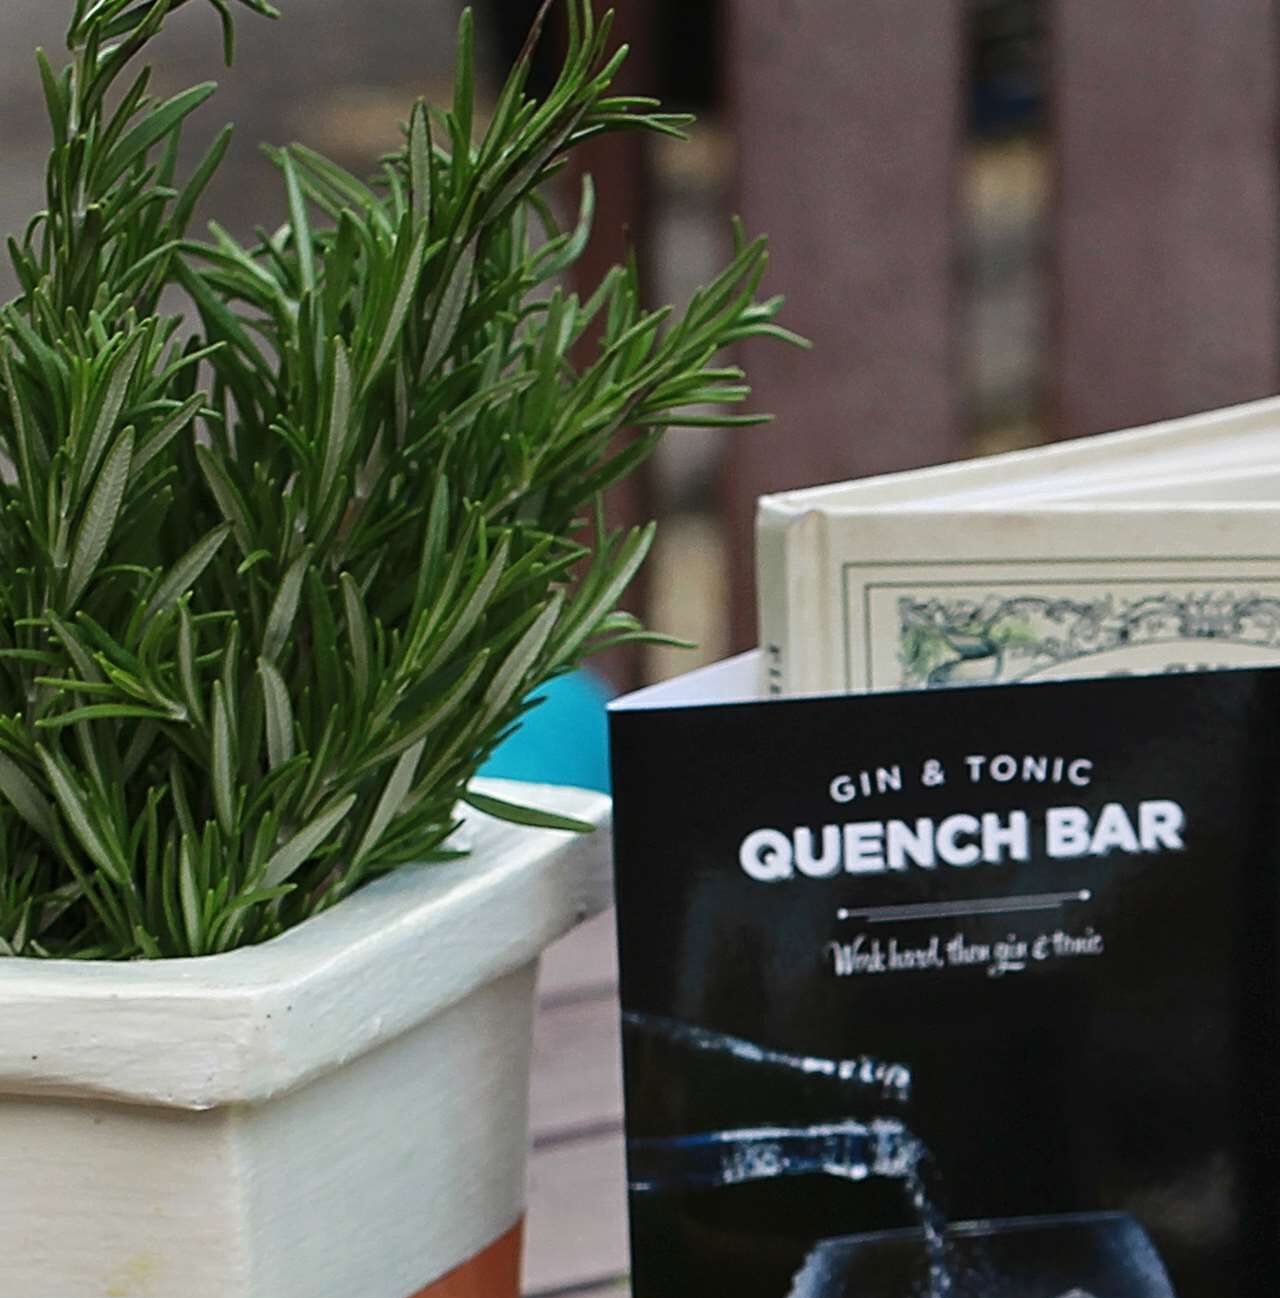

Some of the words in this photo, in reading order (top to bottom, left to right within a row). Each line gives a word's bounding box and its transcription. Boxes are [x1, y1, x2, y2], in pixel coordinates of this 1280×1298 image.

[829, 765, 902, 803] GIN
[921, 759, 945, 787] &
[966, 754, 1094, 786] TONIC
[739, 809, 1030, 882] QUENCH
[1045, 799, 1186, 859] BAR
[986, 933, 1028, 977] gin
